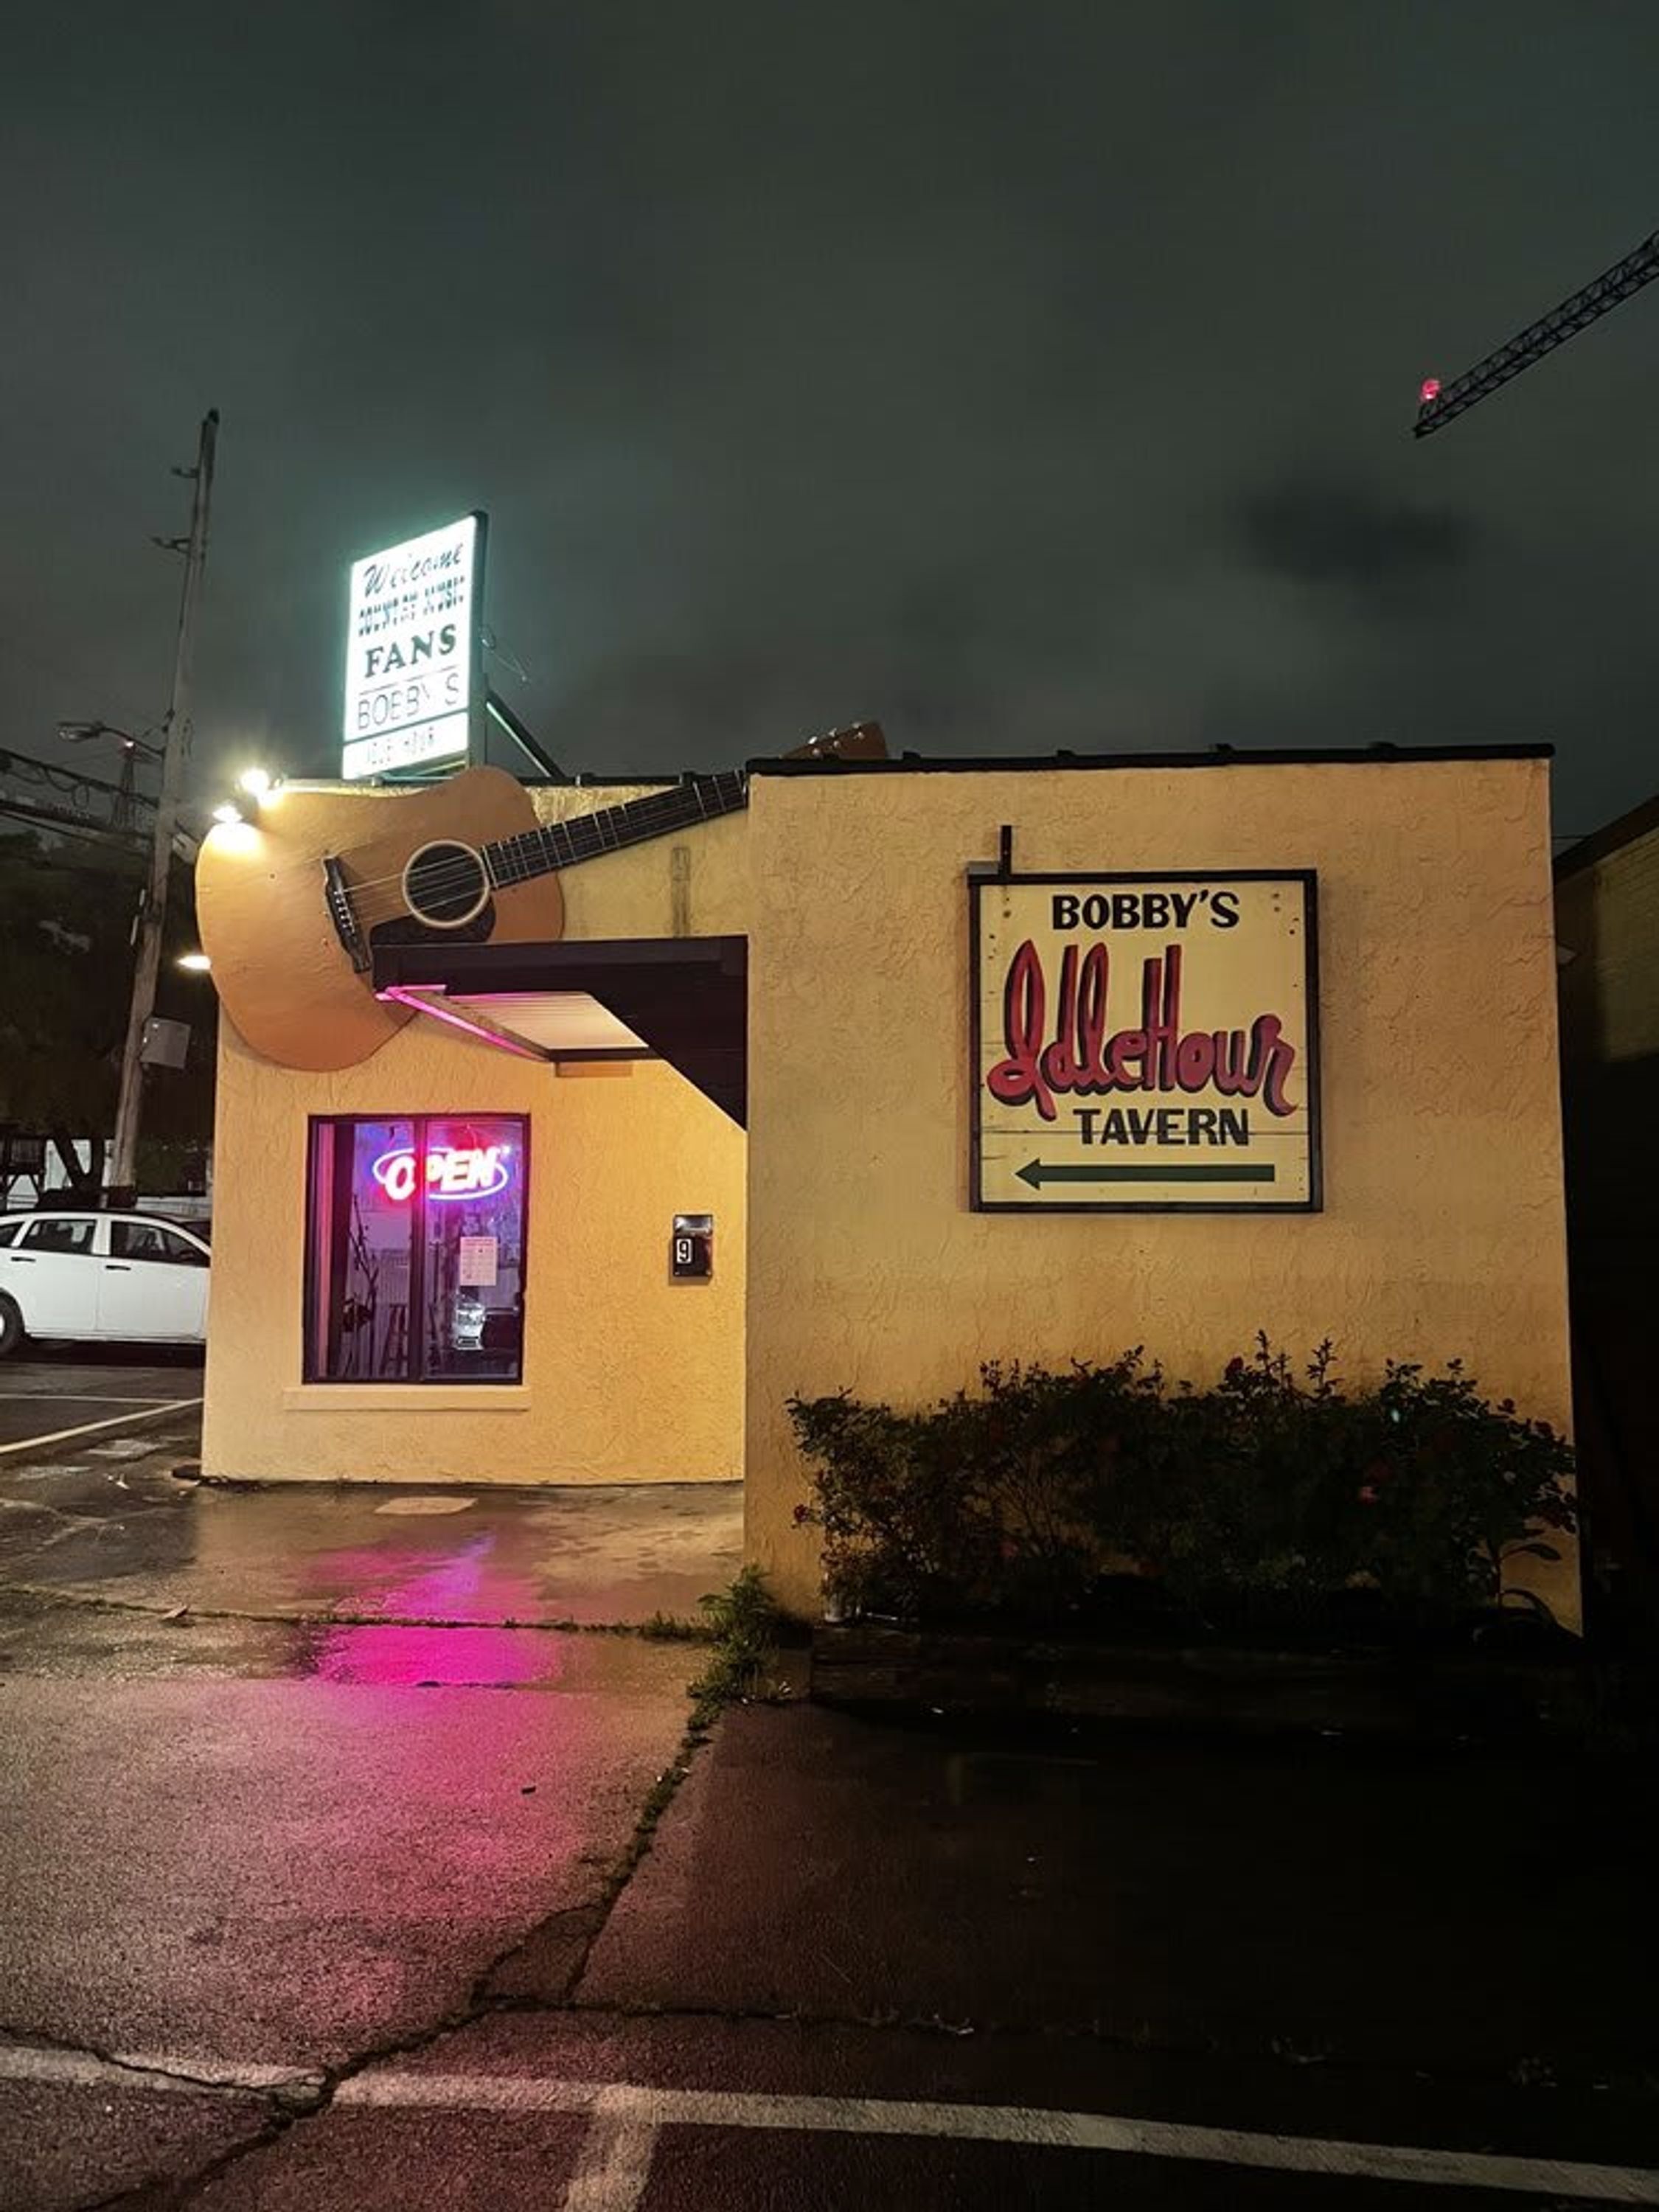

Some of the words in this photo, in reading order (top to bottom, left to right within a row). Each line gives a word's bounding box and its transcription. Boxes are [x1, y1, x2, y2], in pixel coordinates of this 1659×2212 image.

[364, 624, 456, 678] FANS
[1052, 889, 1239, 930] BOBBY'S
[1072, 1108, 1250, 1145] TAVERN
[385, 1147, 500, 1200] OPEN
